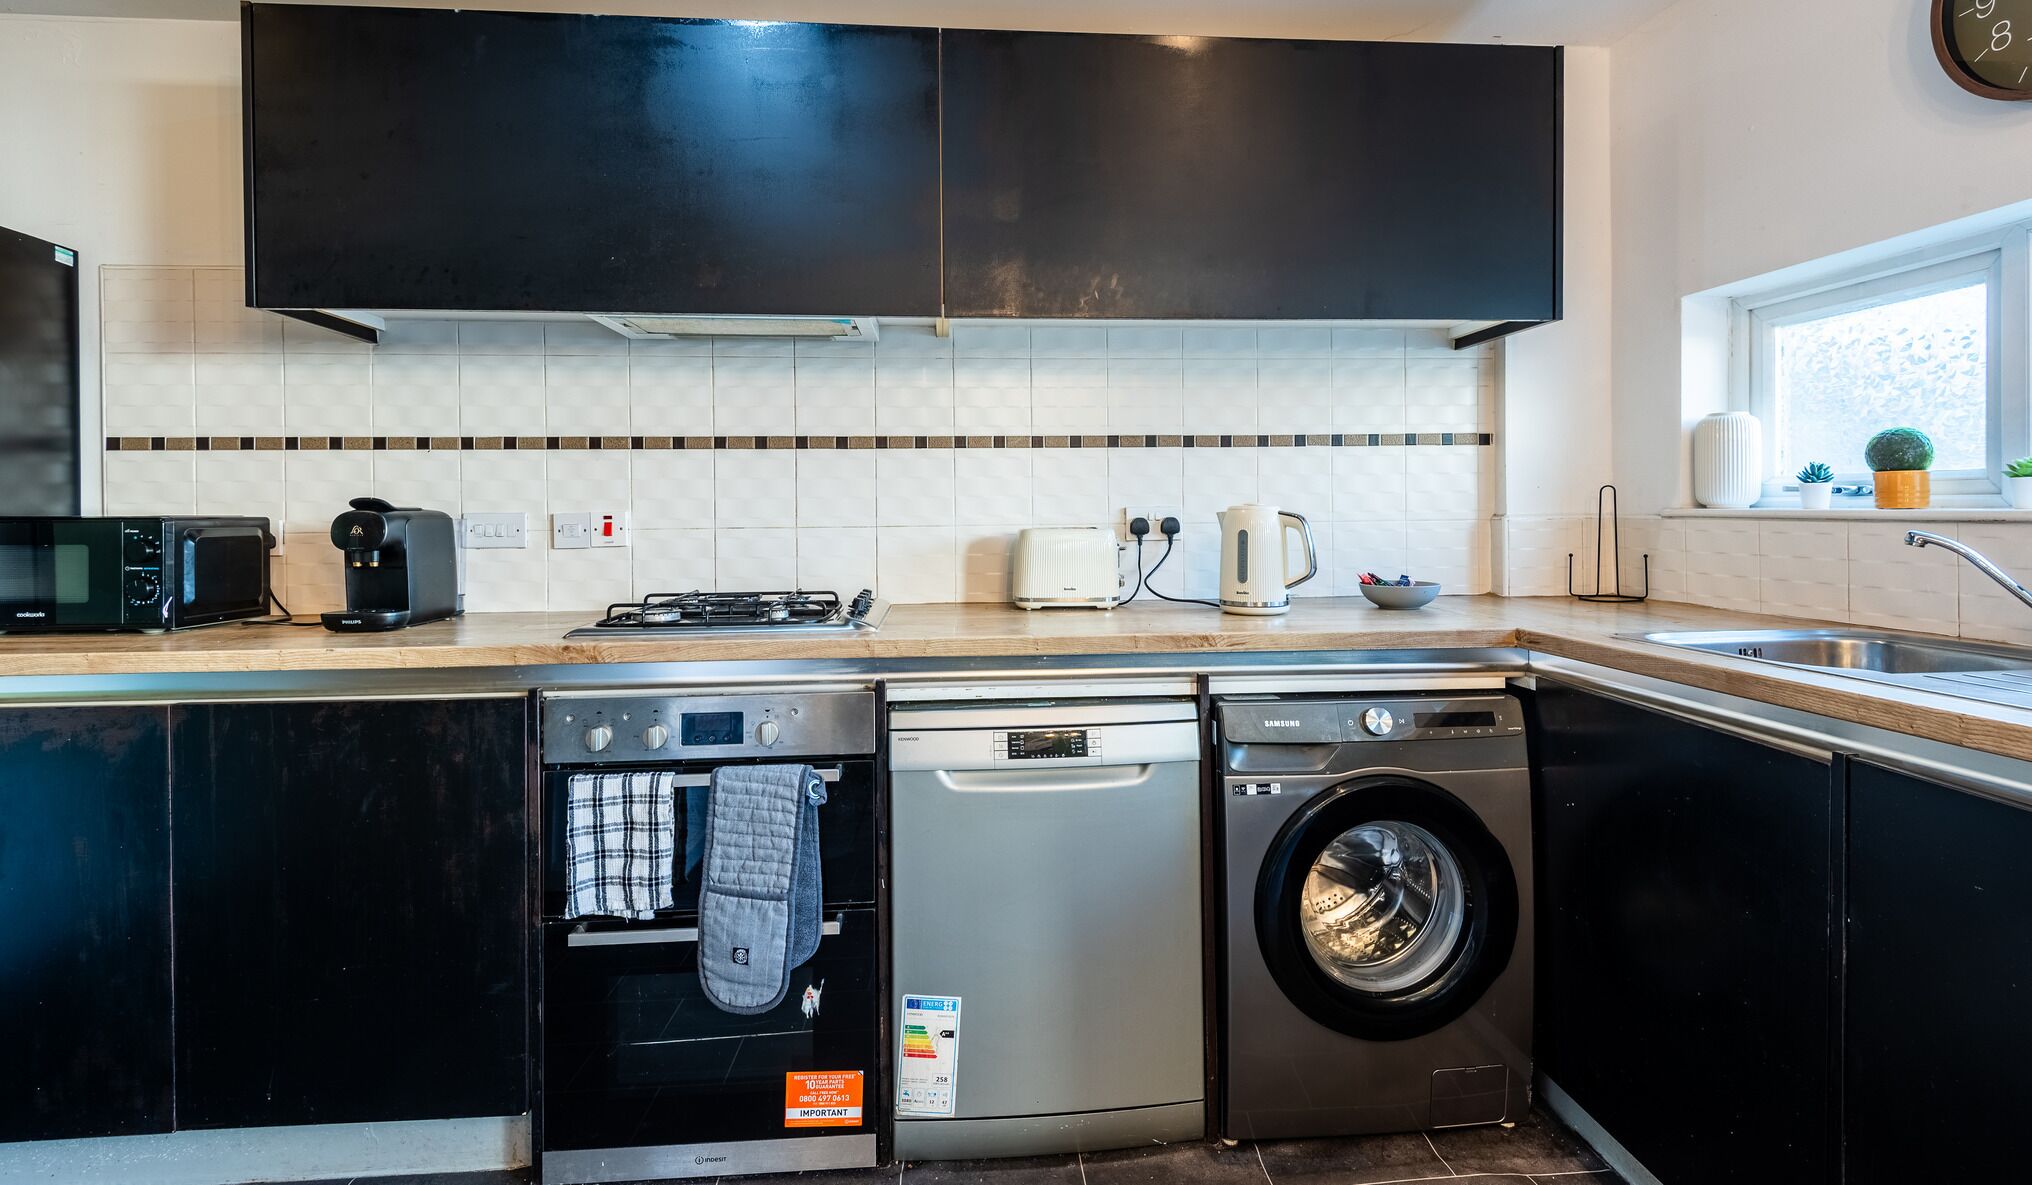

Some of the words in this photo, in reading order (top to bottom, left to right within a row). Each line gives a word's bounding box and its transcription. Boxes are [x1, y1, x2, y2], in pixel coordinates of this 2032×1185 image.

[1991, 20, 2012, 51] 8
[805, 1080, 816, 1089] 10
[800, 1109, 848, 1117] IMPORTANT
